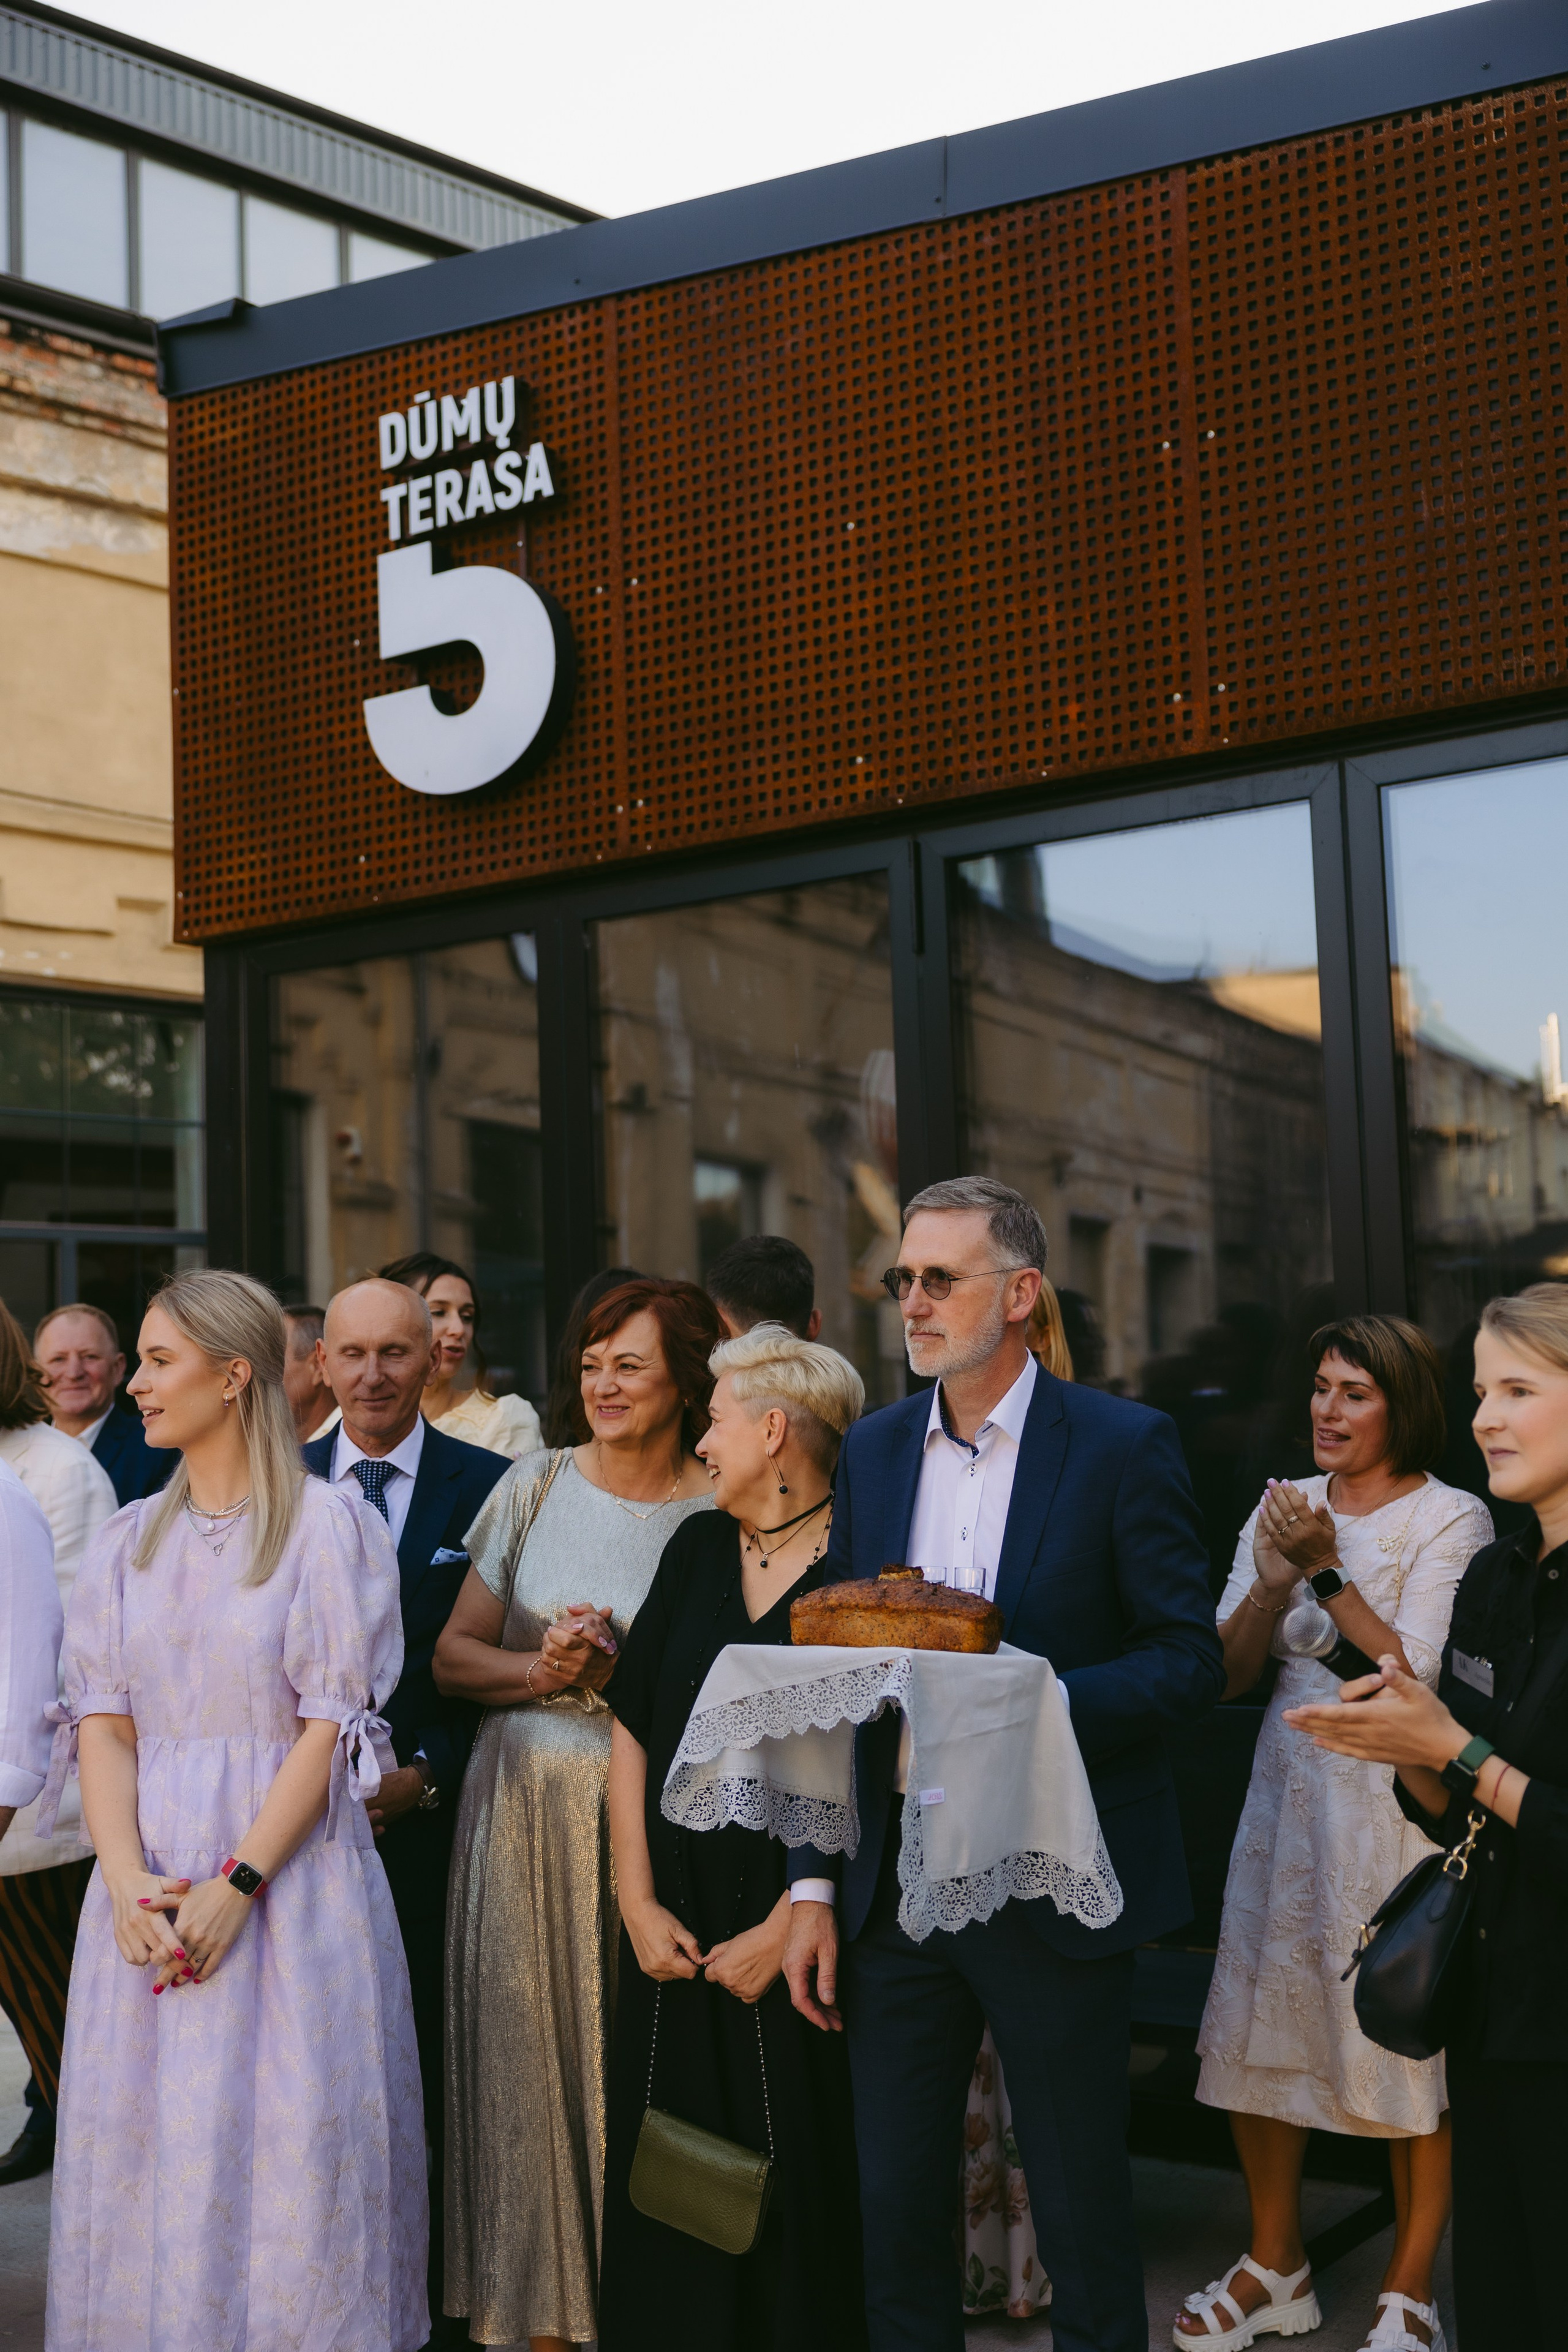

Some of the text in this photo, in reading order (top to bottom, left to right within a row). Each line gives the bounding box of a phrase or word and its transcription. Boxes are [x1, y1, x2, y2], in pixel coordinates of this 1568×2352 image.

[379, 375, 515, 470] DŪMŲ
[380, 442, 554, 541] TERASA
[363, 541, 556, 794] 5
